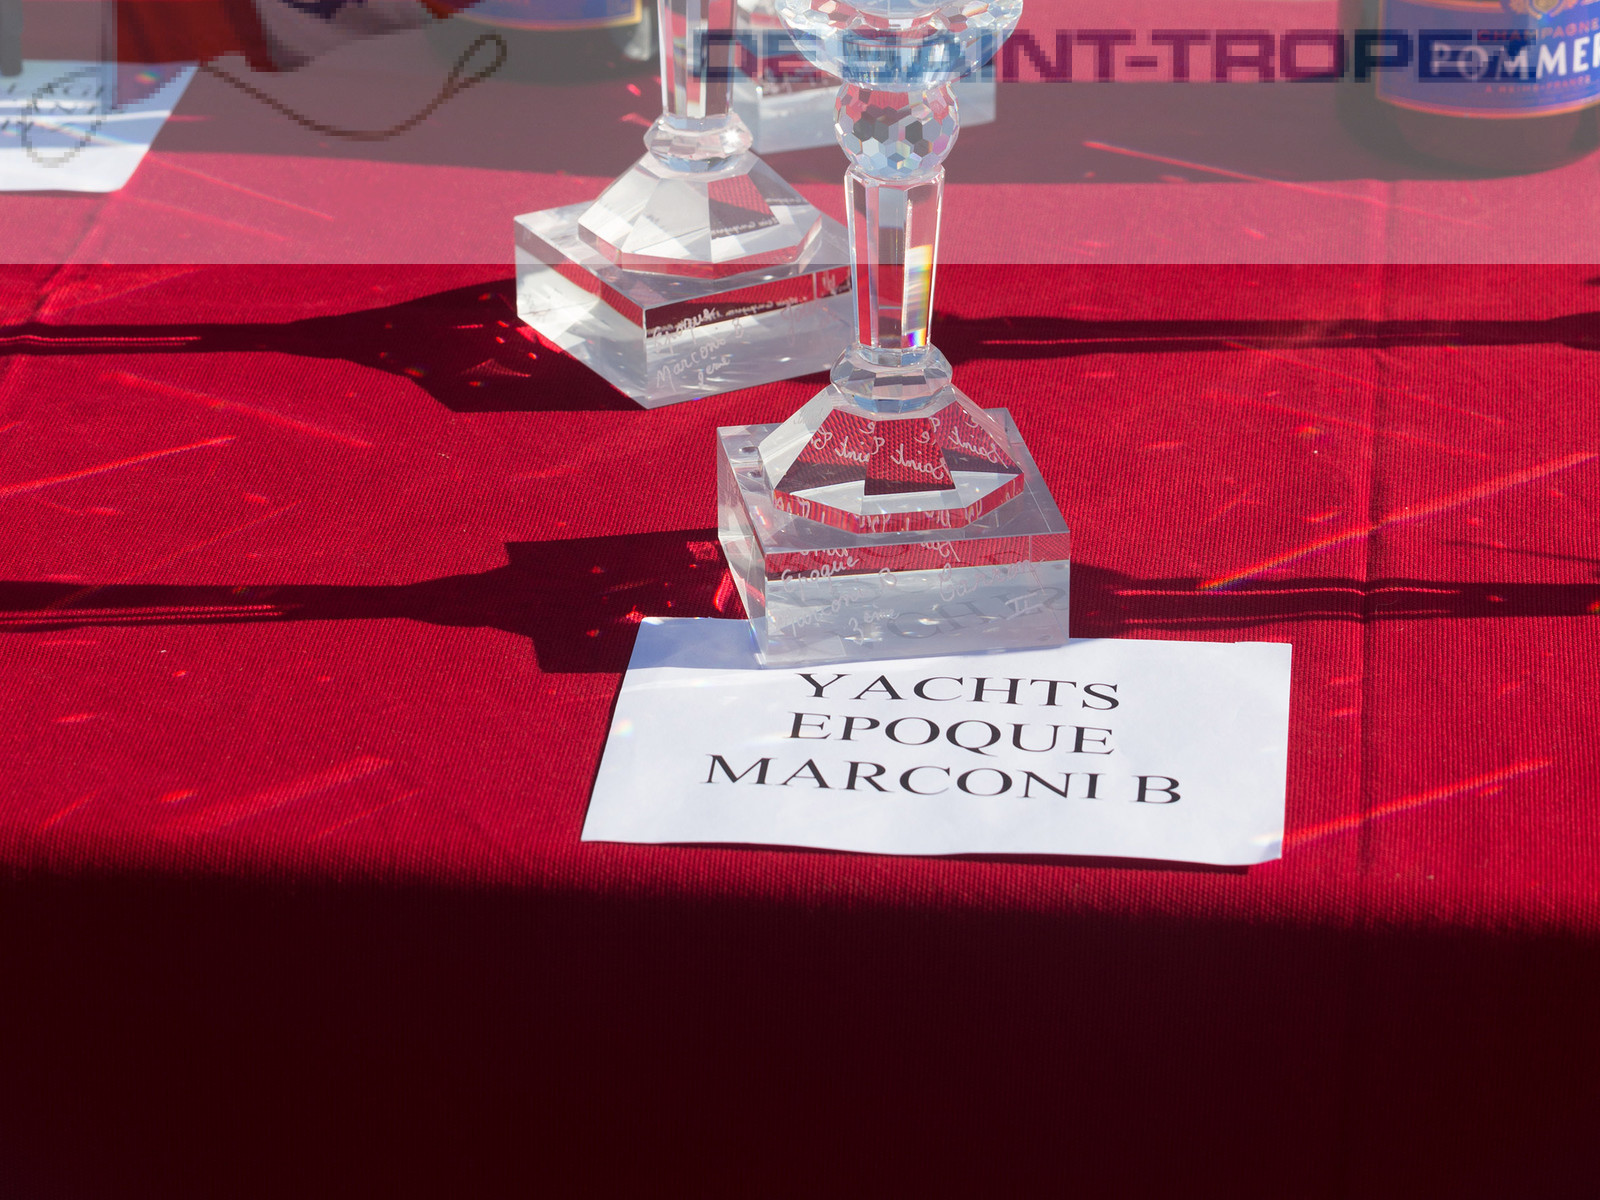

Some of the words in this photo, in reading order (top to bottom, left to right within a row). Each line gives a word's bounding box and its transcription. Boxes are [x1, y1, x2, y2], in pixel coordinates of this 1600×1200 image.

[796, 673, 1120, 711] YACHTS
[786, 711, 1114, 757] EPOQUE
[704, 753, 1107, 800] MARCONI
[1128, 775, 1183, 805] B
